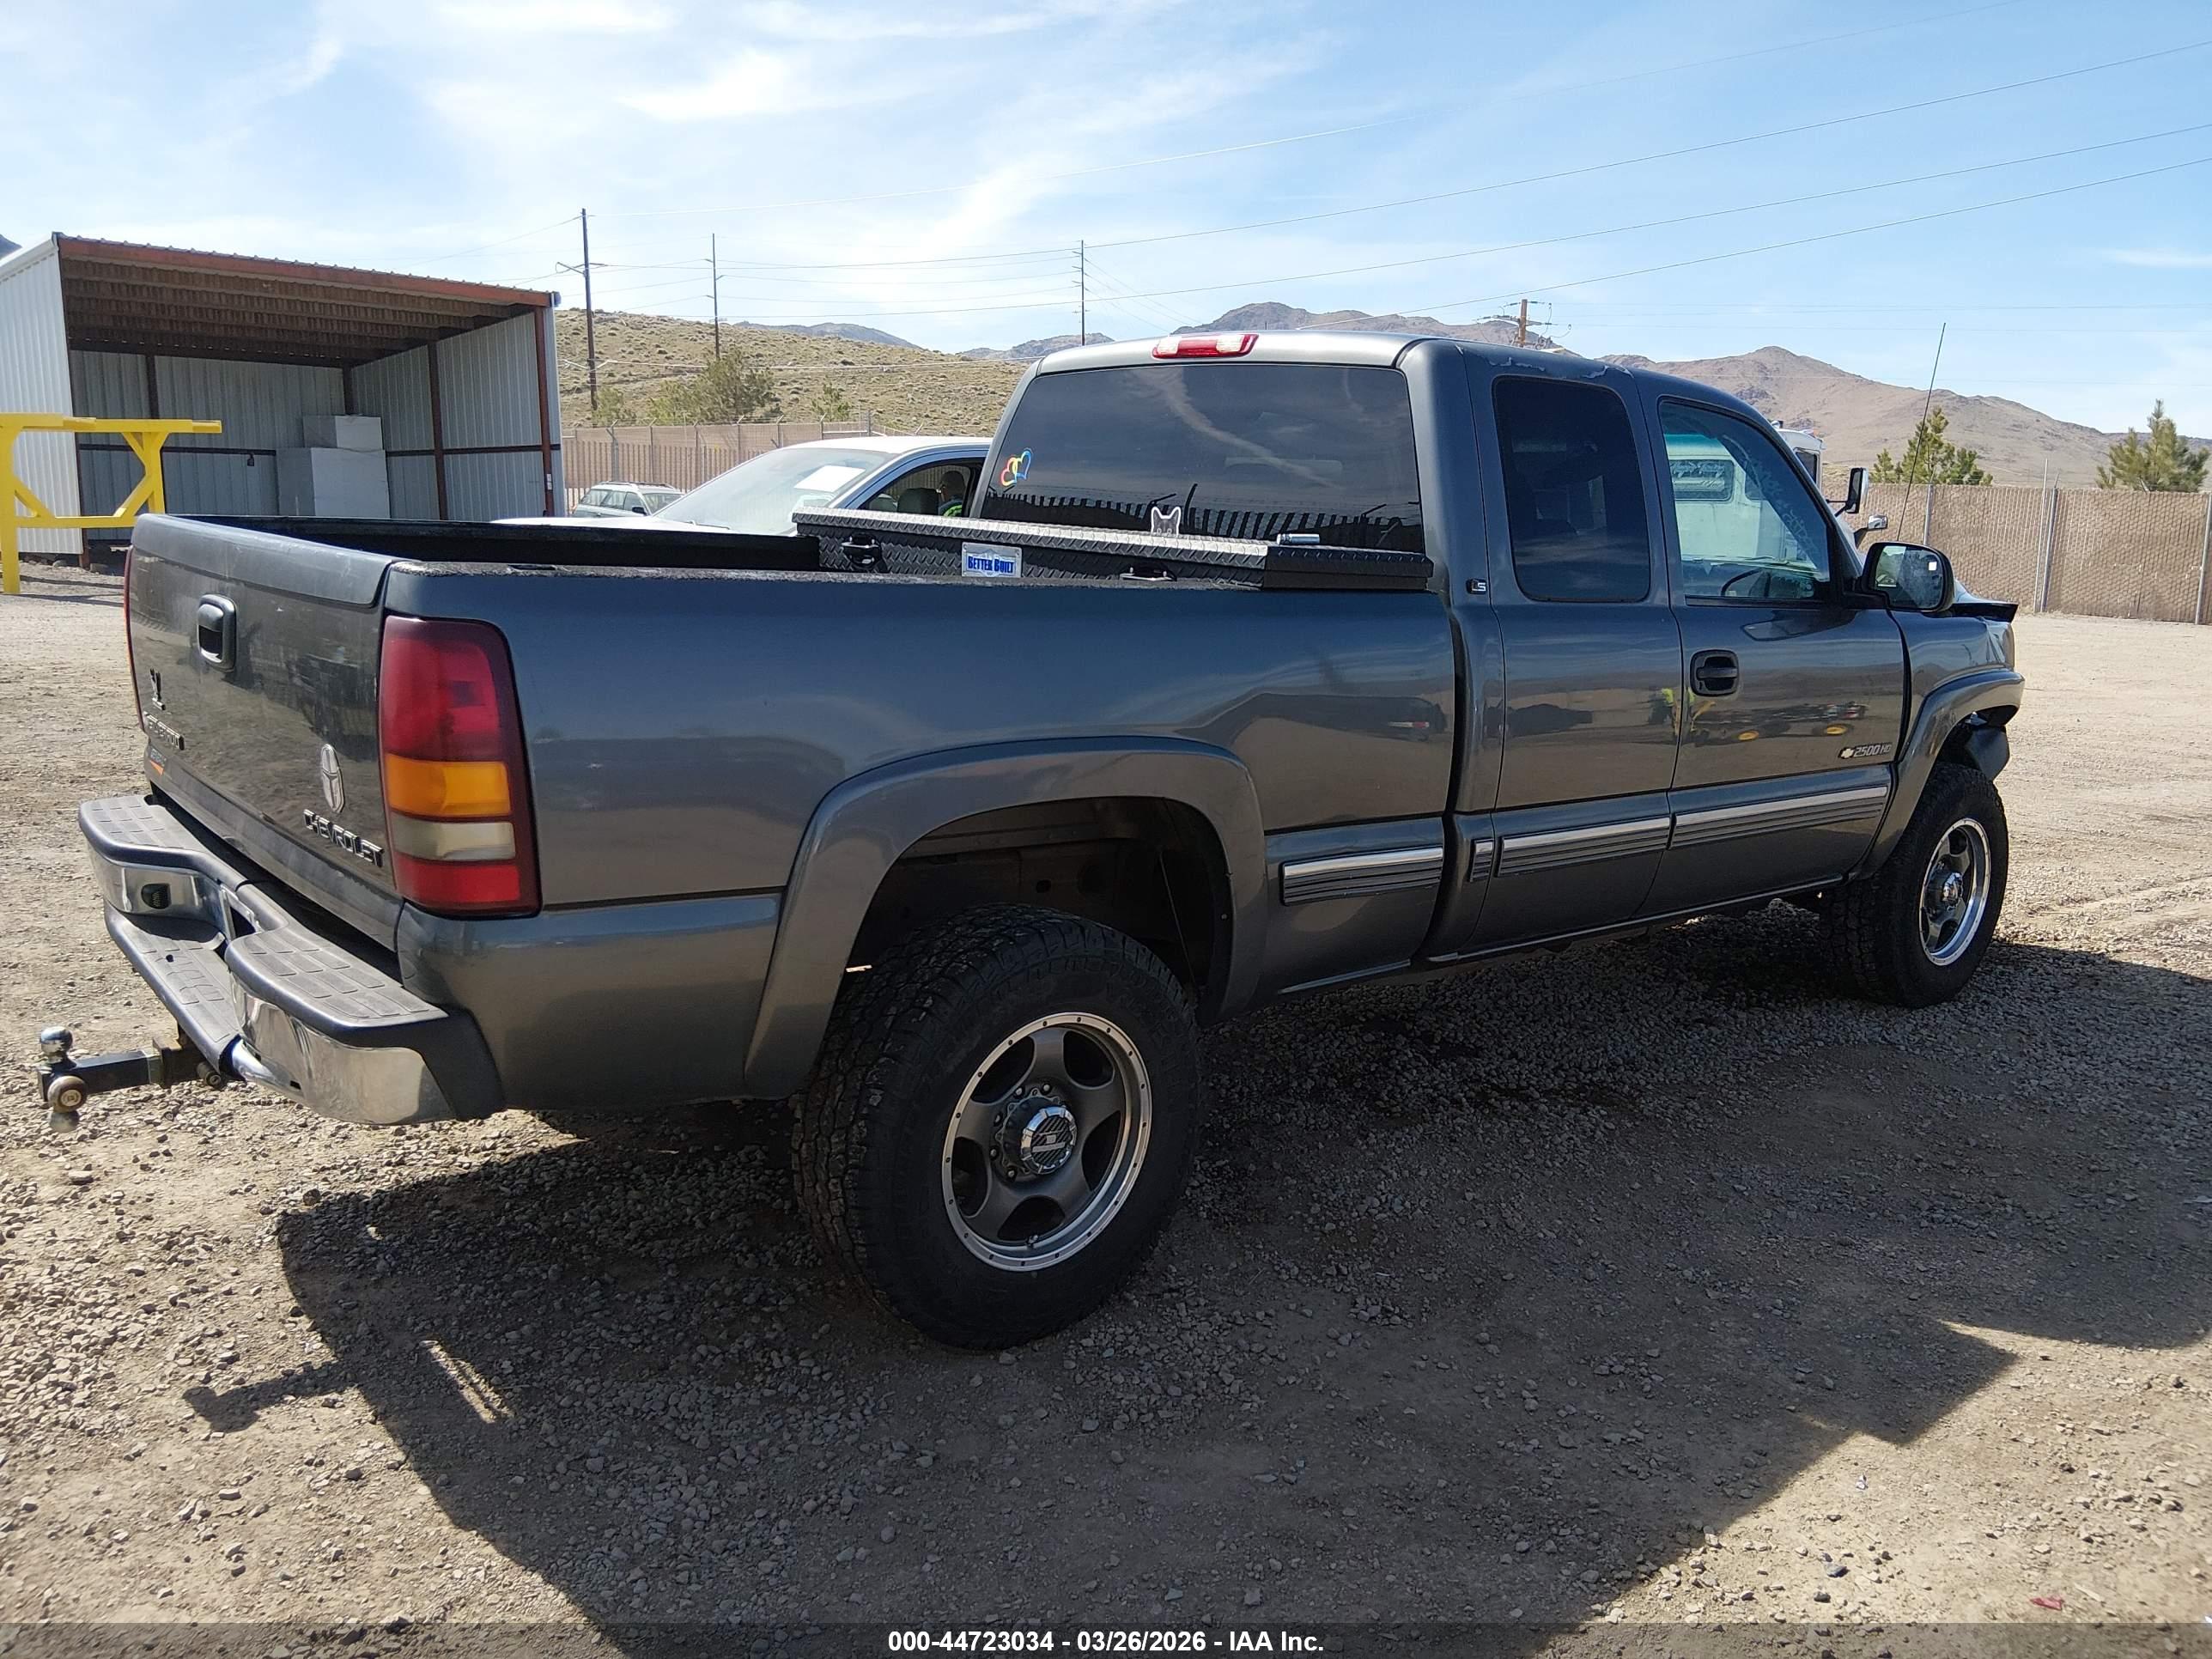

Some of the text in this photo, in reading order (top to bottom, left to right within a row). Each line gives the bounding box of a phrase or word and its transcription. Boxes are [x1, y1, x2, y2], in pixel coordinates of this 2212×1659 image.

[994, 558, 1014, 574] BUILT
[1472, 582, 1486, 592] LS
[303, 809, 384, 866] CHEVROLET
